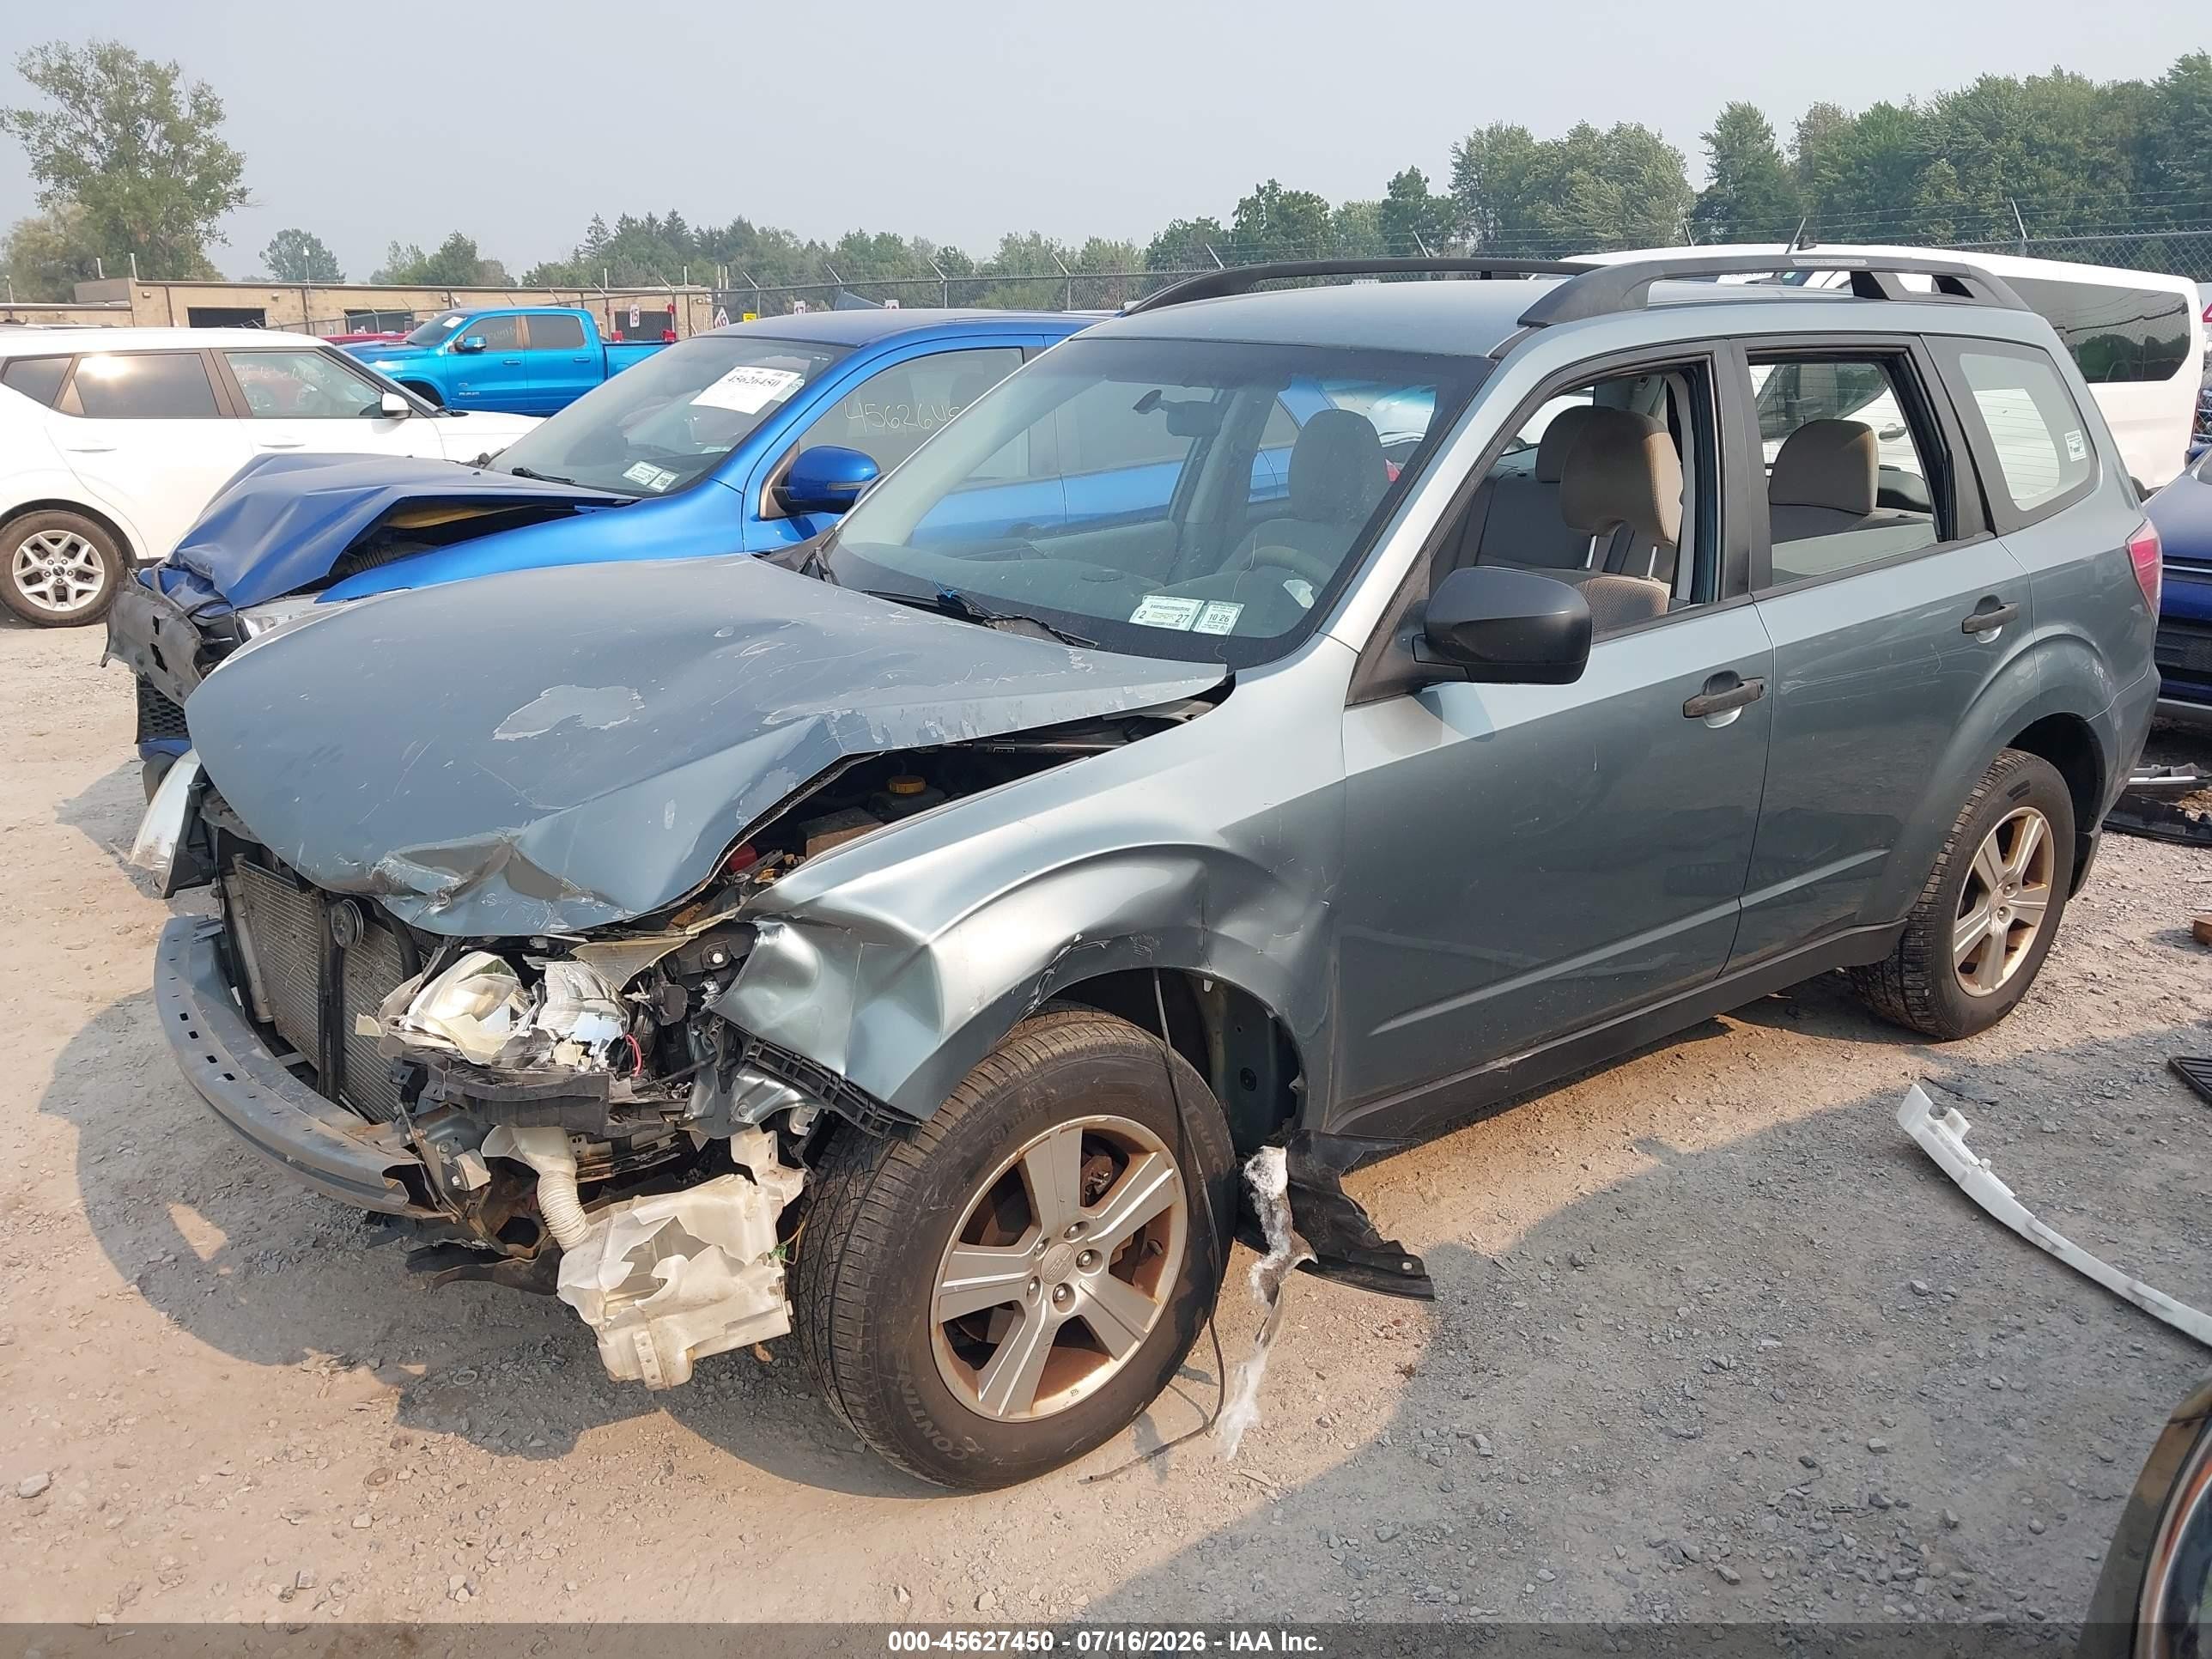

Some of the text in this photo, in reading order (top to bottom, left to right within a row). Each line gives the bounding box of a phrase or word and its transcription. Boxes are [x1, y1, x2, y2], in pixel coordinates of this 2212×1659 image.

[630, 308, 639, 324] 15
[1139, 611, 1147, 619] 2
[1175, 614, 1189, 623] 27
[1219, 614, 1230, 623] 26
